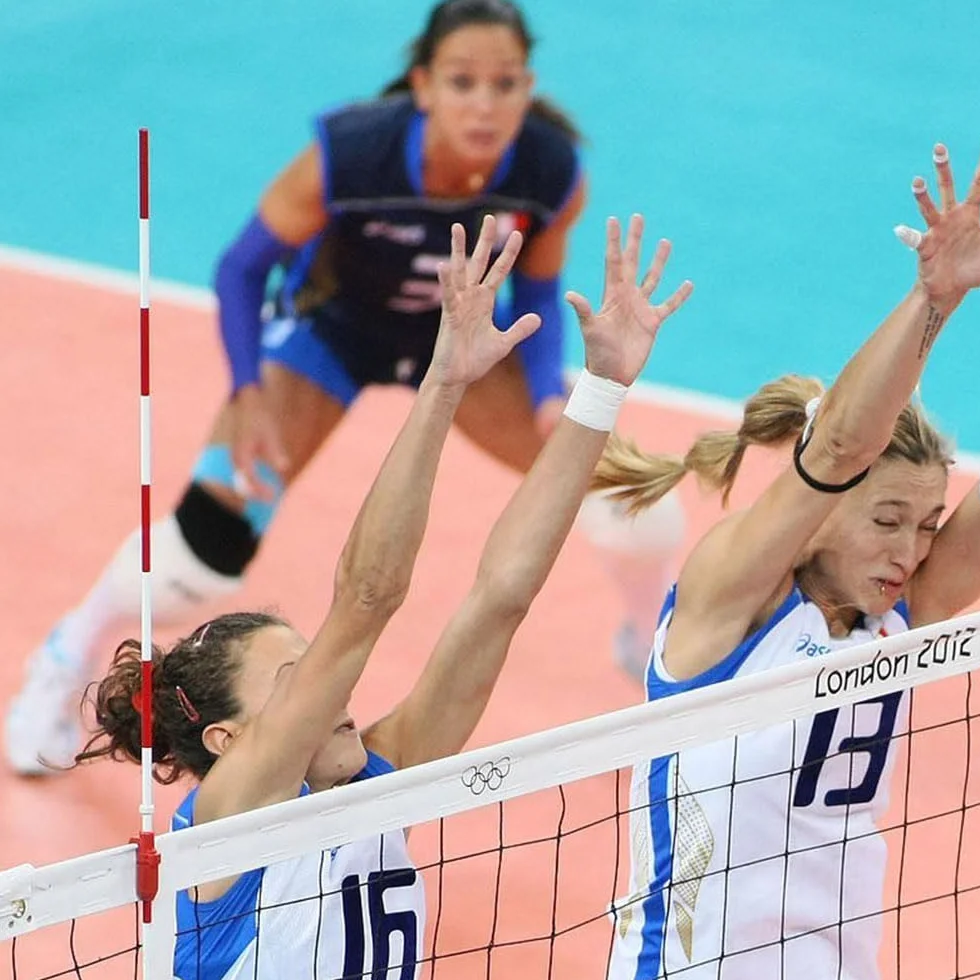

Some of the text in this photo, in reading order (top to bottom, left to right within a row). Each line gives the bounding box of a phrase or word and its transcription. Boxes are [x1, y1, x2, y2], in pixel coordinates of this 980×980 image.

[814, 627, 977, 698] London 2012
[793, 690, 904, 808] 13
